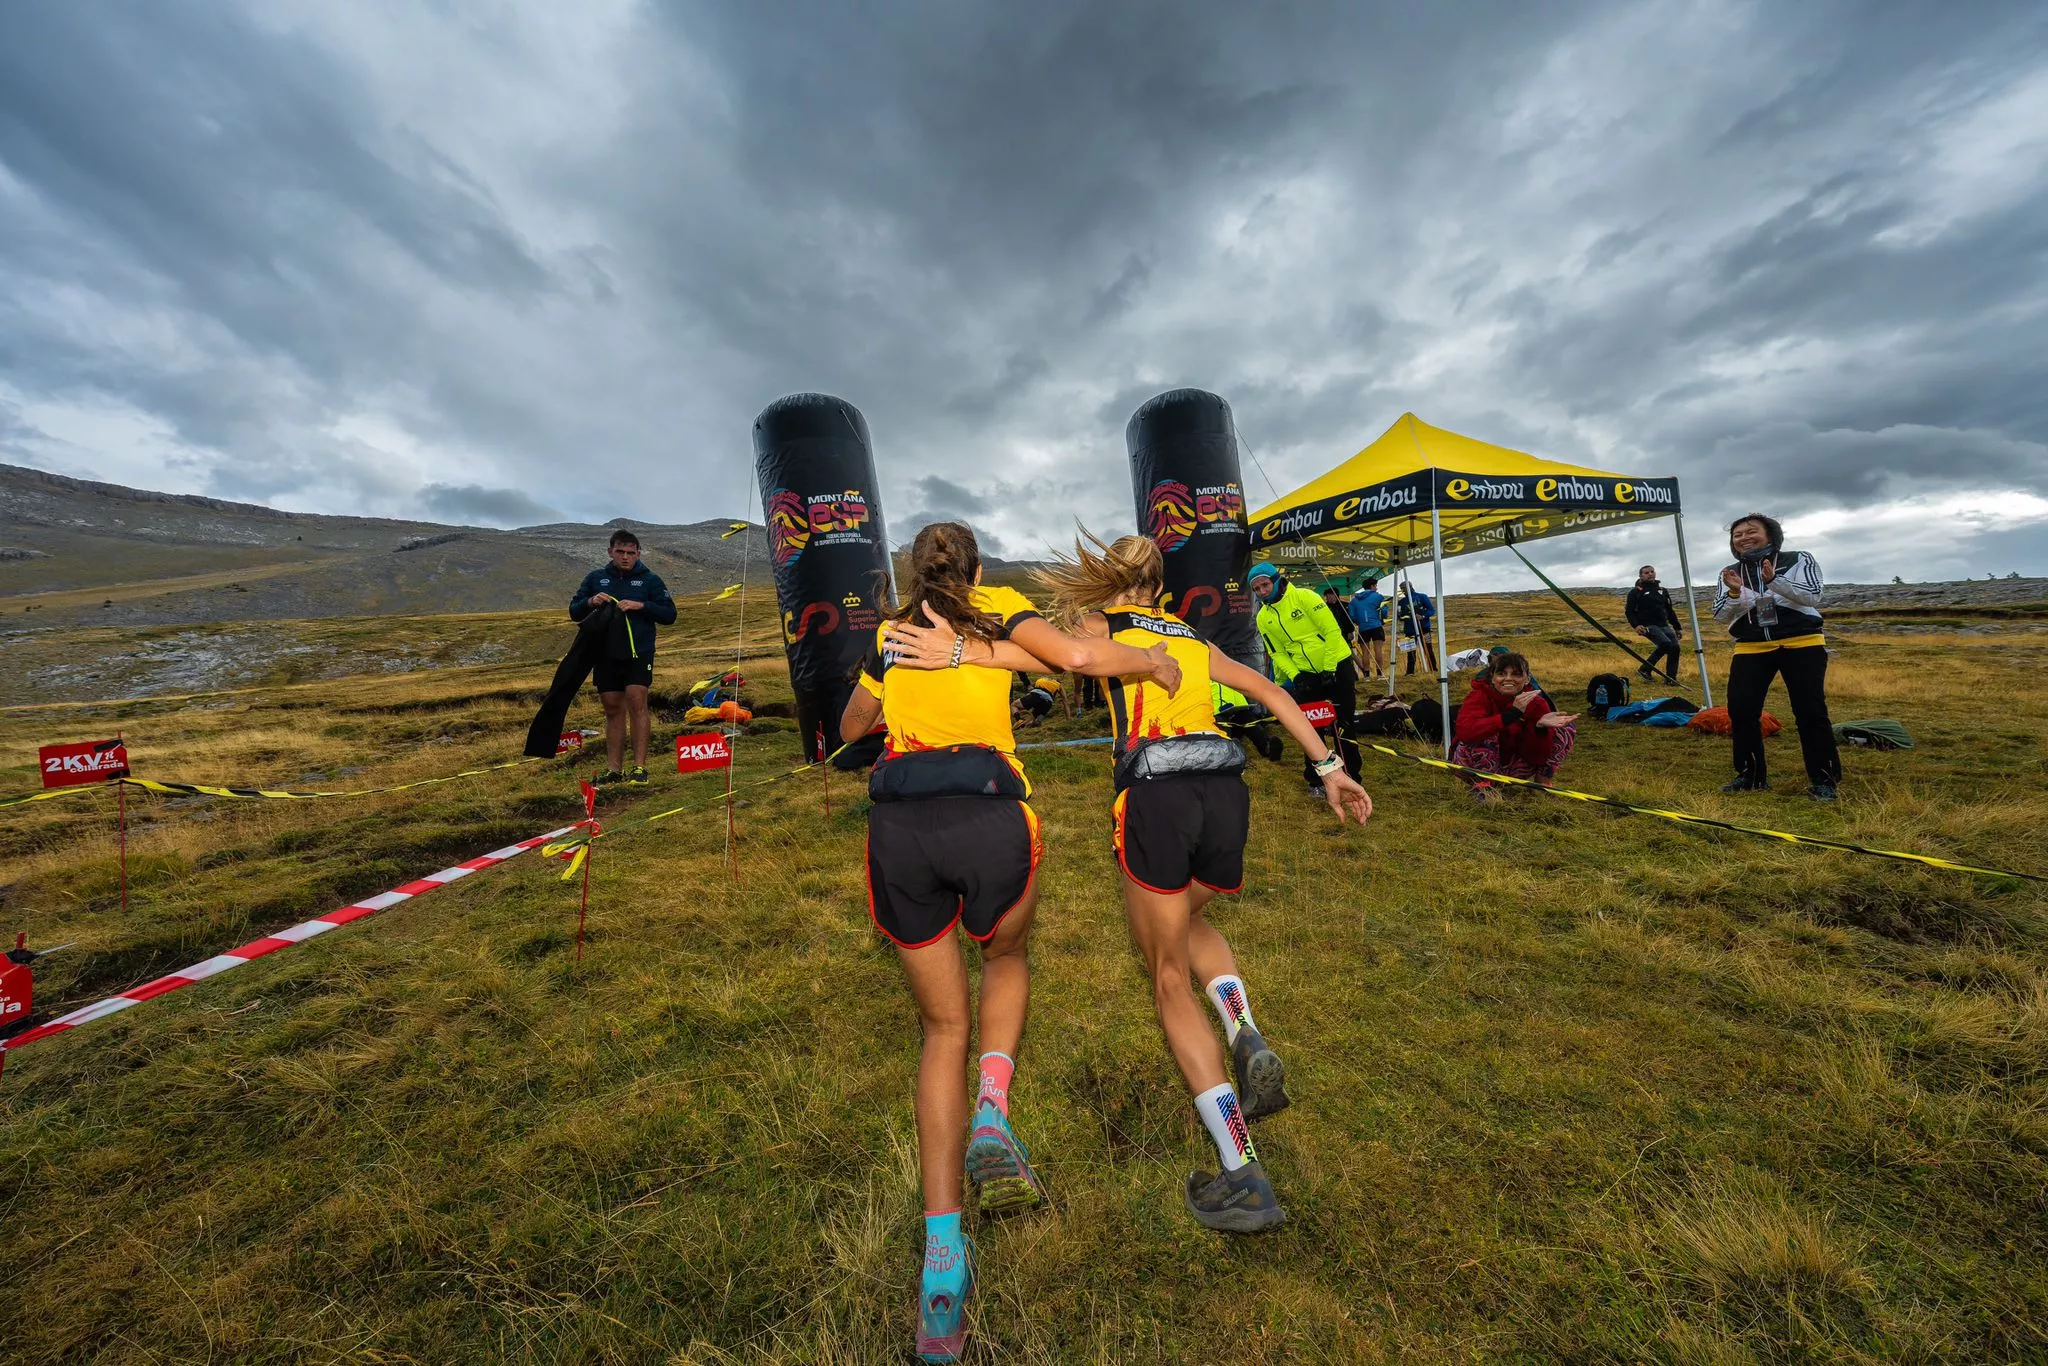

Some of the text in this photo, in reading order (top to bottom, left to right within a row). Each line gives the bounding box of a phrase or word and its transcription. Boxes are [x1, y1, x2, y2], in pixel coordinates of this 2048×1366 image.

[808, 489, 866, 504] MONTAÑA
[1196, 483, 1240, 496] MONTAÑA
[1446, 476, 1672, 504] embou embou embou
[1262, 509, 1323, 541] embou
[1334, 486, 1417, 521] embou
[1304, 707, 1323, 720] KV
[680, 743, 716, 760] 2KV
[45, 752, 104, 773] 2KV
[70, 761, 124, 774] collarada
